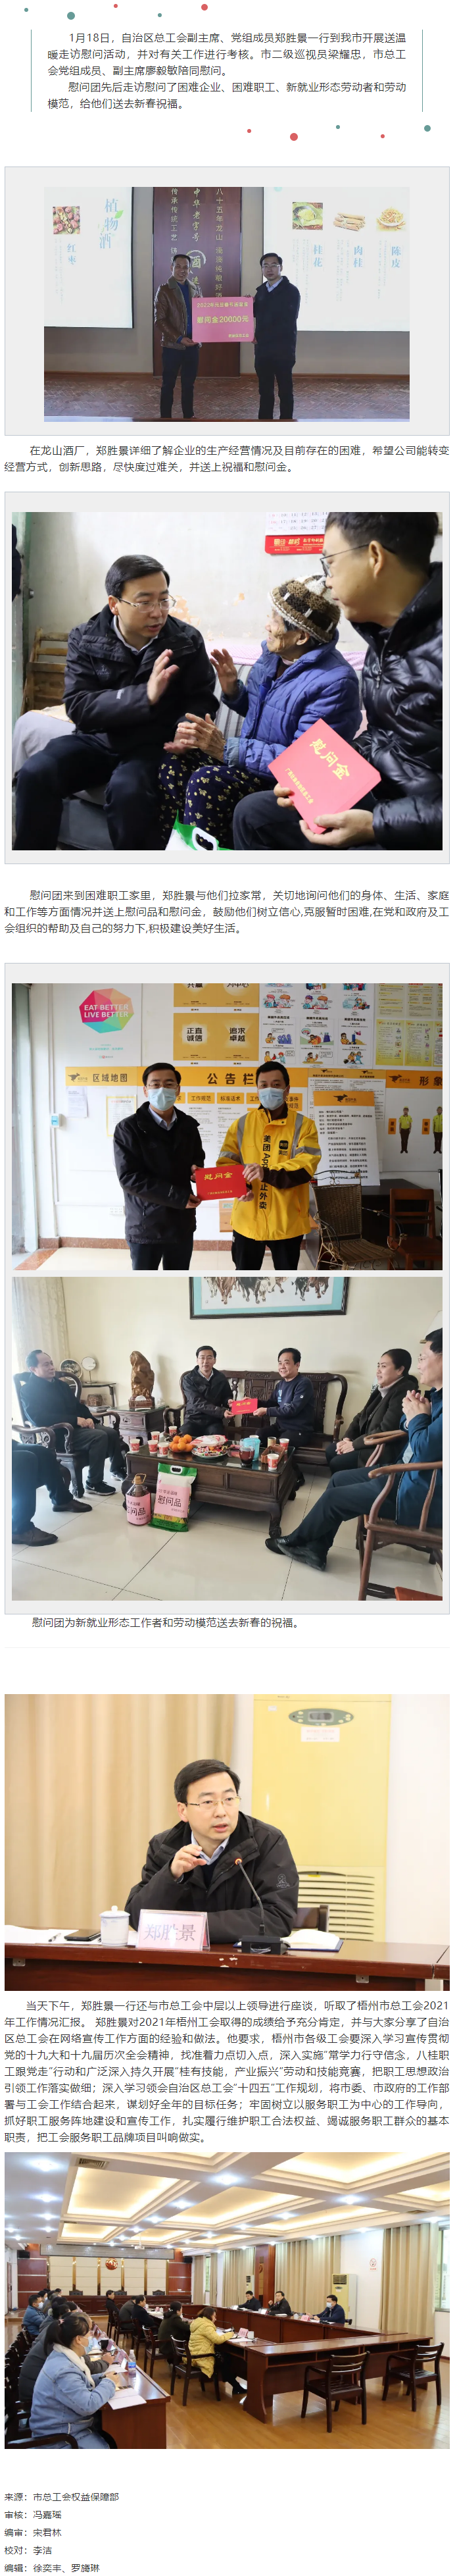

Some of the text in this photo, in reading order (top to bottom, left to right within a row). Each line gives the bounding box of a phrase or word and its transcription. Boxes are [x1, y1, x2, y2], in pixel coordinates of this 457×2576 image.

[192, 188, 201, 242] 中华老字号
[67, 244, 76, 265] 红枣
[313, 244, 323, 268] 桂花
[353, 245, 363, 268] 肉桂
[391, 245, 401, 268] 陈皮
[197, 315, 249, 324] 慰问金20000元
[309, 738, 350, 780] 慰问金
[93, 1073, 128, 1083] 区域地图
[207, 1073, 254, 1085] 公告栏
[204, 1172, 233, 1180] 慰问金
[158, 1495, 181, 1507] 慰问品
[143, 1924, 197, 1942] 郑胜景
